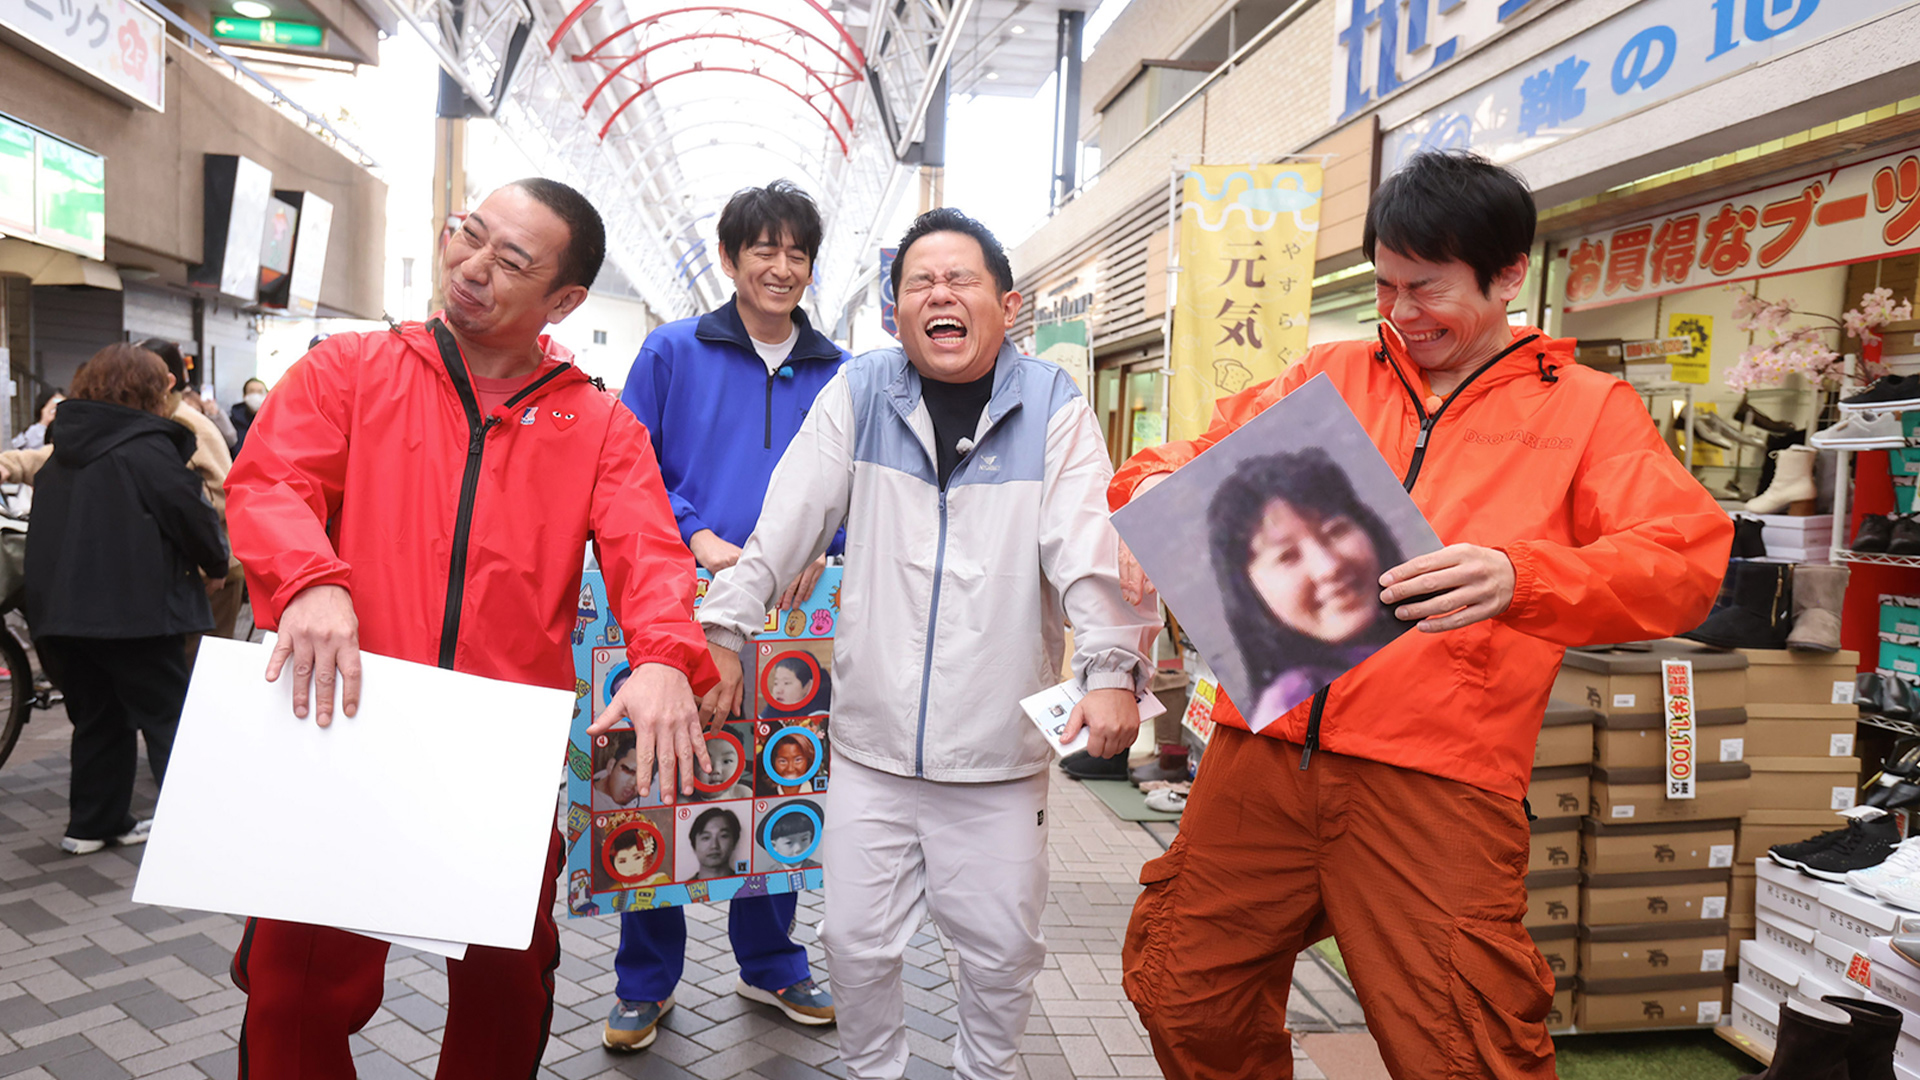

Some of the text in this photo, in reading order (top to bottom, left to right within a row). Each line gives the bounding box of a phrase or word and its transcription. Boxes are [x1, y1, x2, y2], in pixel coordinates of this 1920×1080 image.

[123, 33, 145, 69] 2F
[1566, 155, 1920, 302] お買得なブーツ
[1213, 240, 1268, 350] 元気
[1668, 697, 1692, 780] ¥1,100
[1767, 884, 1811, 911] Risata
[1765, 927, 1808, 955] Risata
